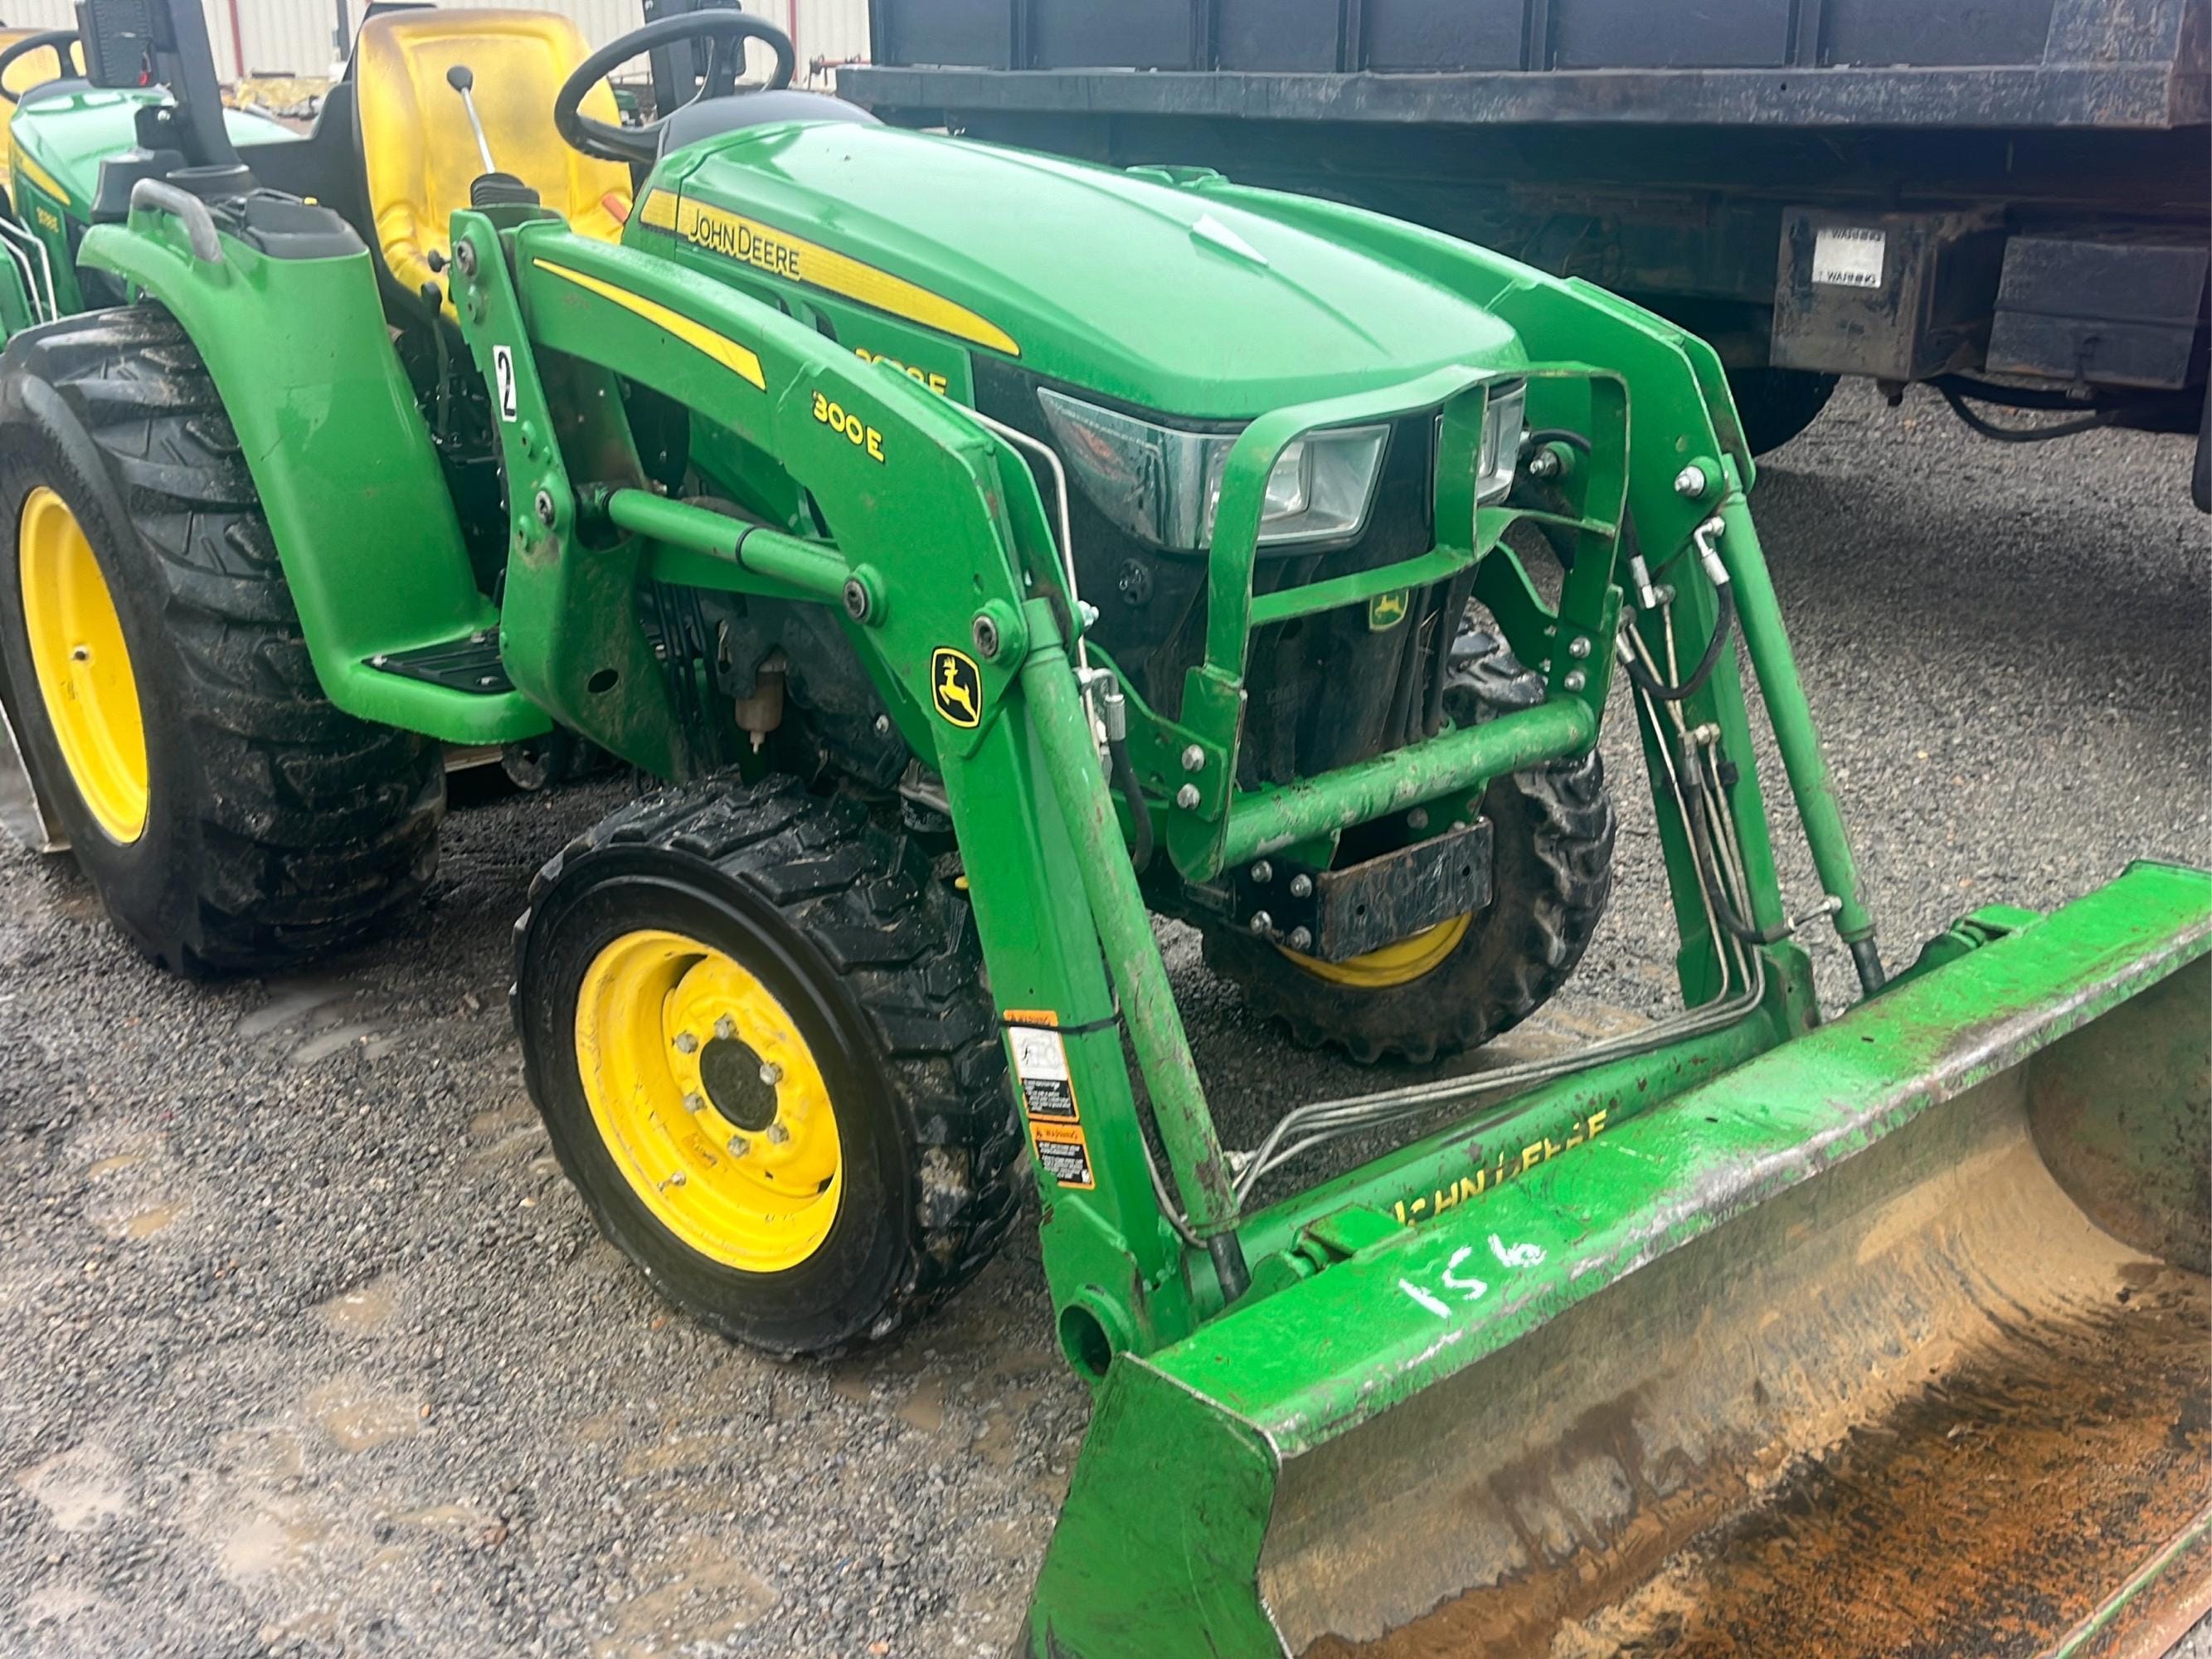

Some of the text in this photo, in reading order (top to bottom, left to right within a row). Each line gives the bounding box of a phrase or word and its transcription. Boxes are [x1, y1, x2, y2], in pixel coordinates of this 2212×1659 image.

[690, 208, 800, 275] JOHN DEERE
[498, 351, 516, 416] 2
